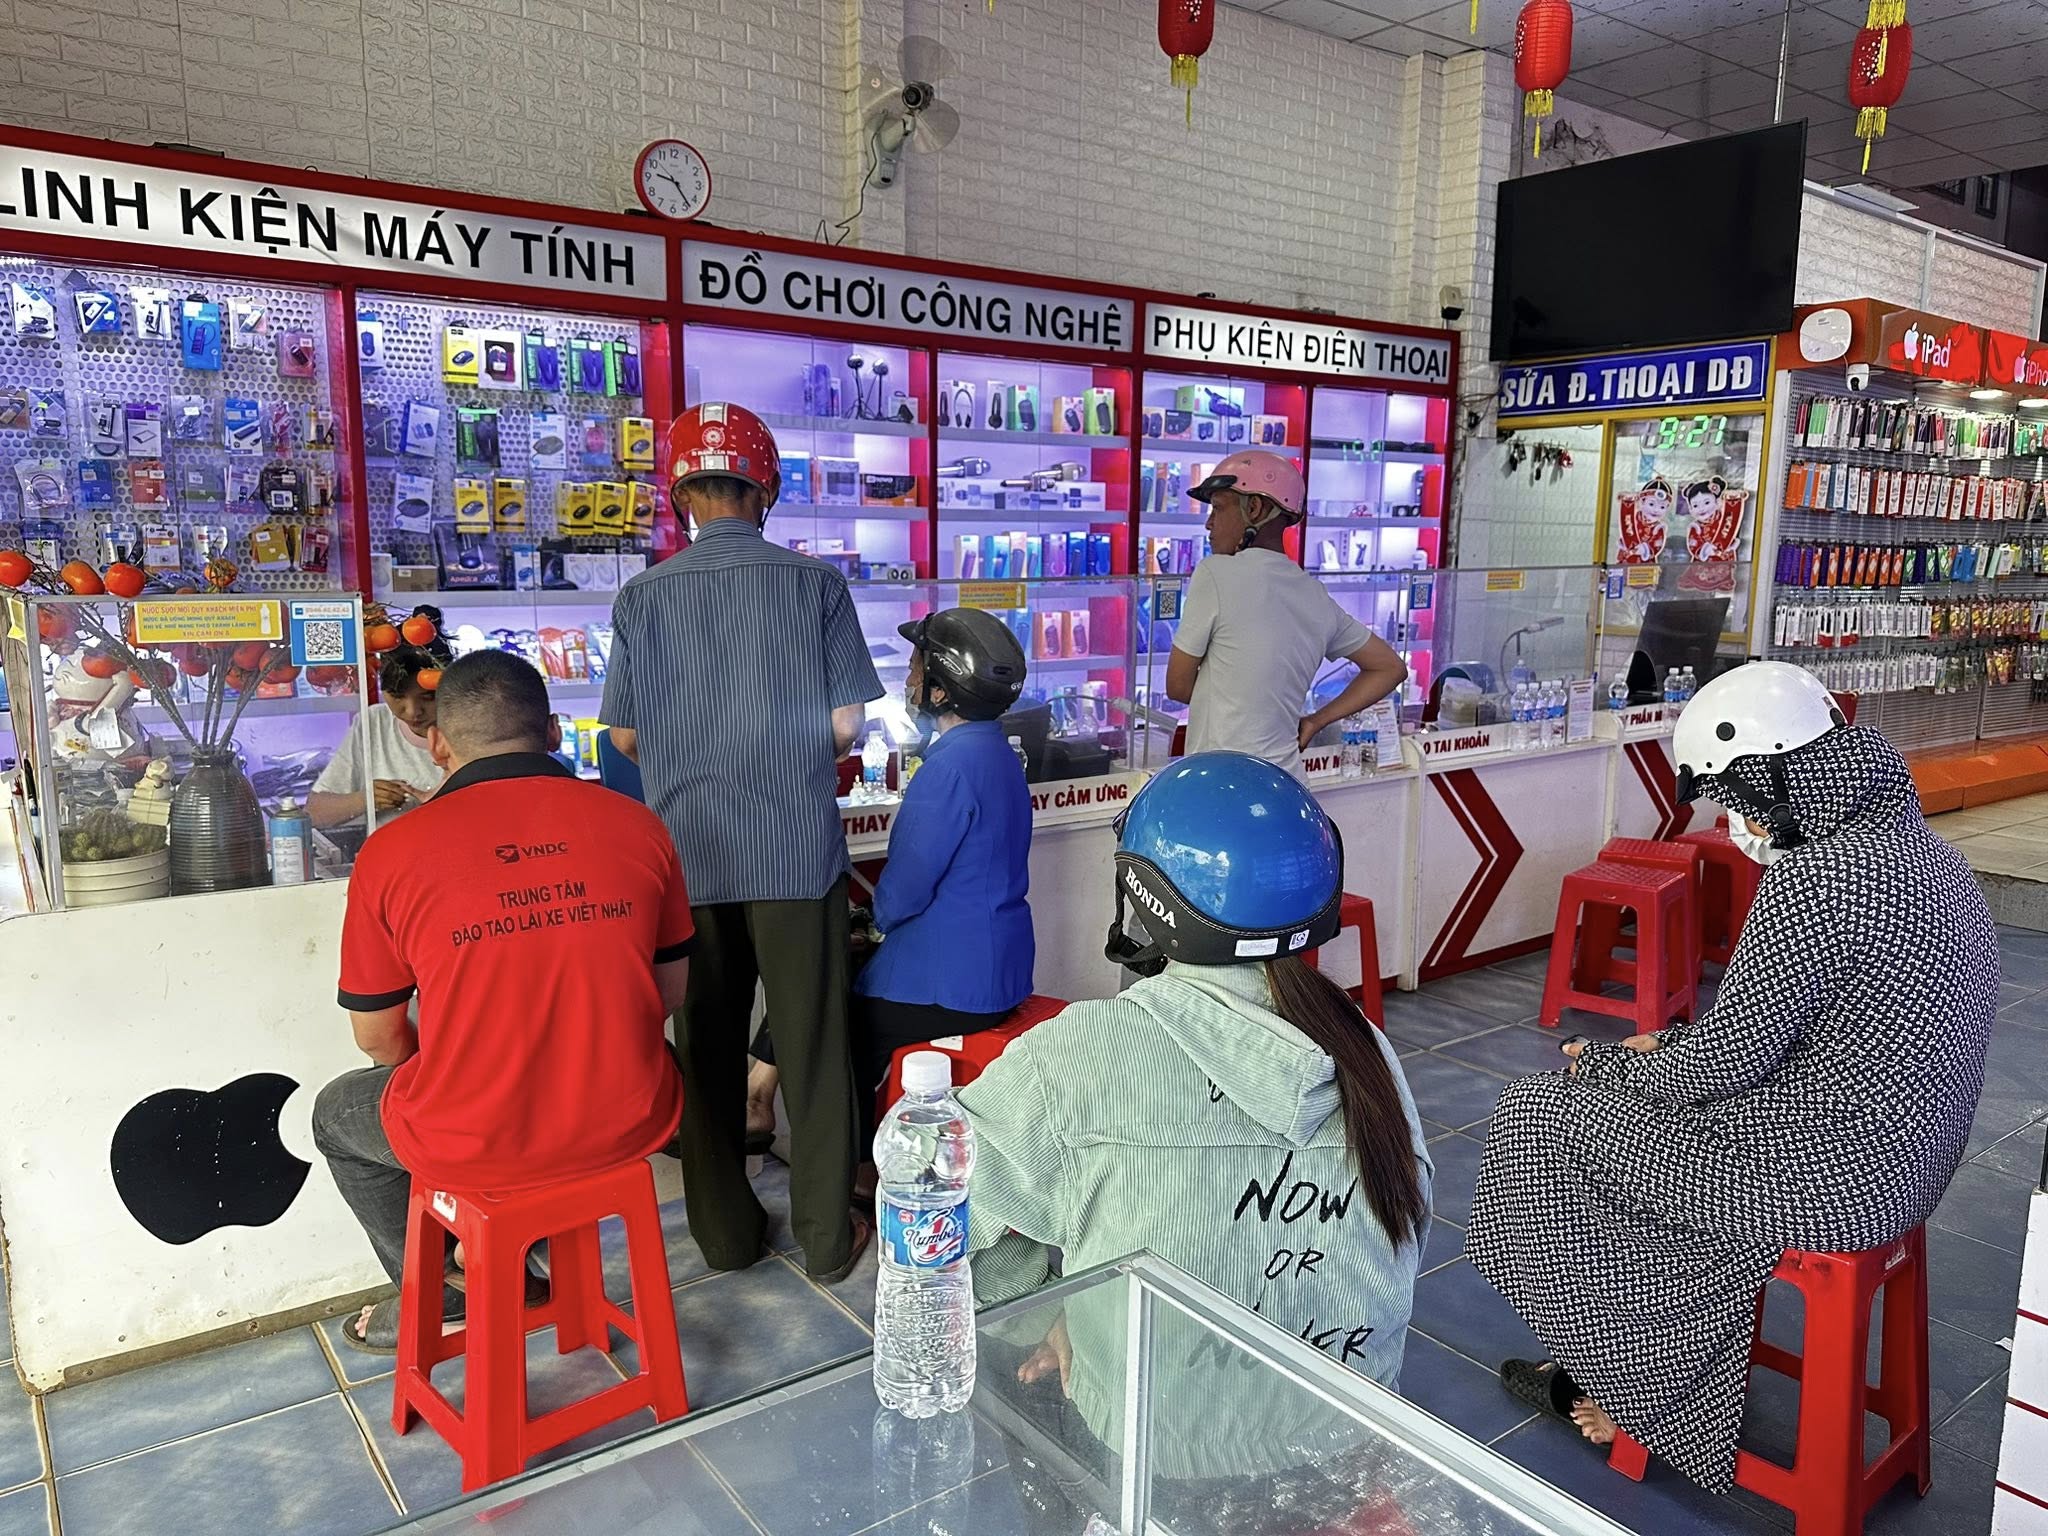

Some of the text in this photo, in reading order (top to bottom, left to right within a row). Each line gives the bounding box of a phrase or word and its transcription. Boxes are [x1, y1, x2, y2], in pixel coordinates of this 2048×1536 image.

[649, 158, 658, 169] 10
[658, 149, 666, 161] 11
[669, 148, 680, 159] 12
[644, 171, 652, 182] 9
[692, 166, 699, 177] 2
[648, 186, 656, 197] 8
[695, 180, 702, 191] 3
[657, 197, 665, 207] 7
[669, 203, 677, 214] 6
[691, 194, 697, 204] 4
[0, 167, 635, 286] INH KIỆN MÁY TÍNH
[699, 250, 1122, 352] ĐỒ CHƠI CÔNG NGHỆ
[1153, 315, 1448, 383] PHỤ KIỆN ĐIỆN THOẠI
[1920, 333, 1952, 369] iPad
[1501, 368, 1556, 408] SỬA
[1706, 355, 1754, 393] DĐ
[2025, 361, 2048, 387] iPho
[1657, 415, 1727, 449] 9:21
[1302, 756, 1329, 772] HAY
[1030, 793, 1050, 811] AY
[1054, 784, 1091, 808] CẢM
[842, 813, 891, 836] THAY
[521, 841, 569, 857] VNDC
[496, 879, 587, 910] TRUNG TÂM
[1125, 866, 1178, 929] HONDA
[451, 922, 483, 947] ĐÀO
[518, 909, 544, 932] LÁI
[544, 908, 566, 927] XE
[1233, 1150, 1359, 1225] NOW
[1264, 1247, 1325, 1280] OR
